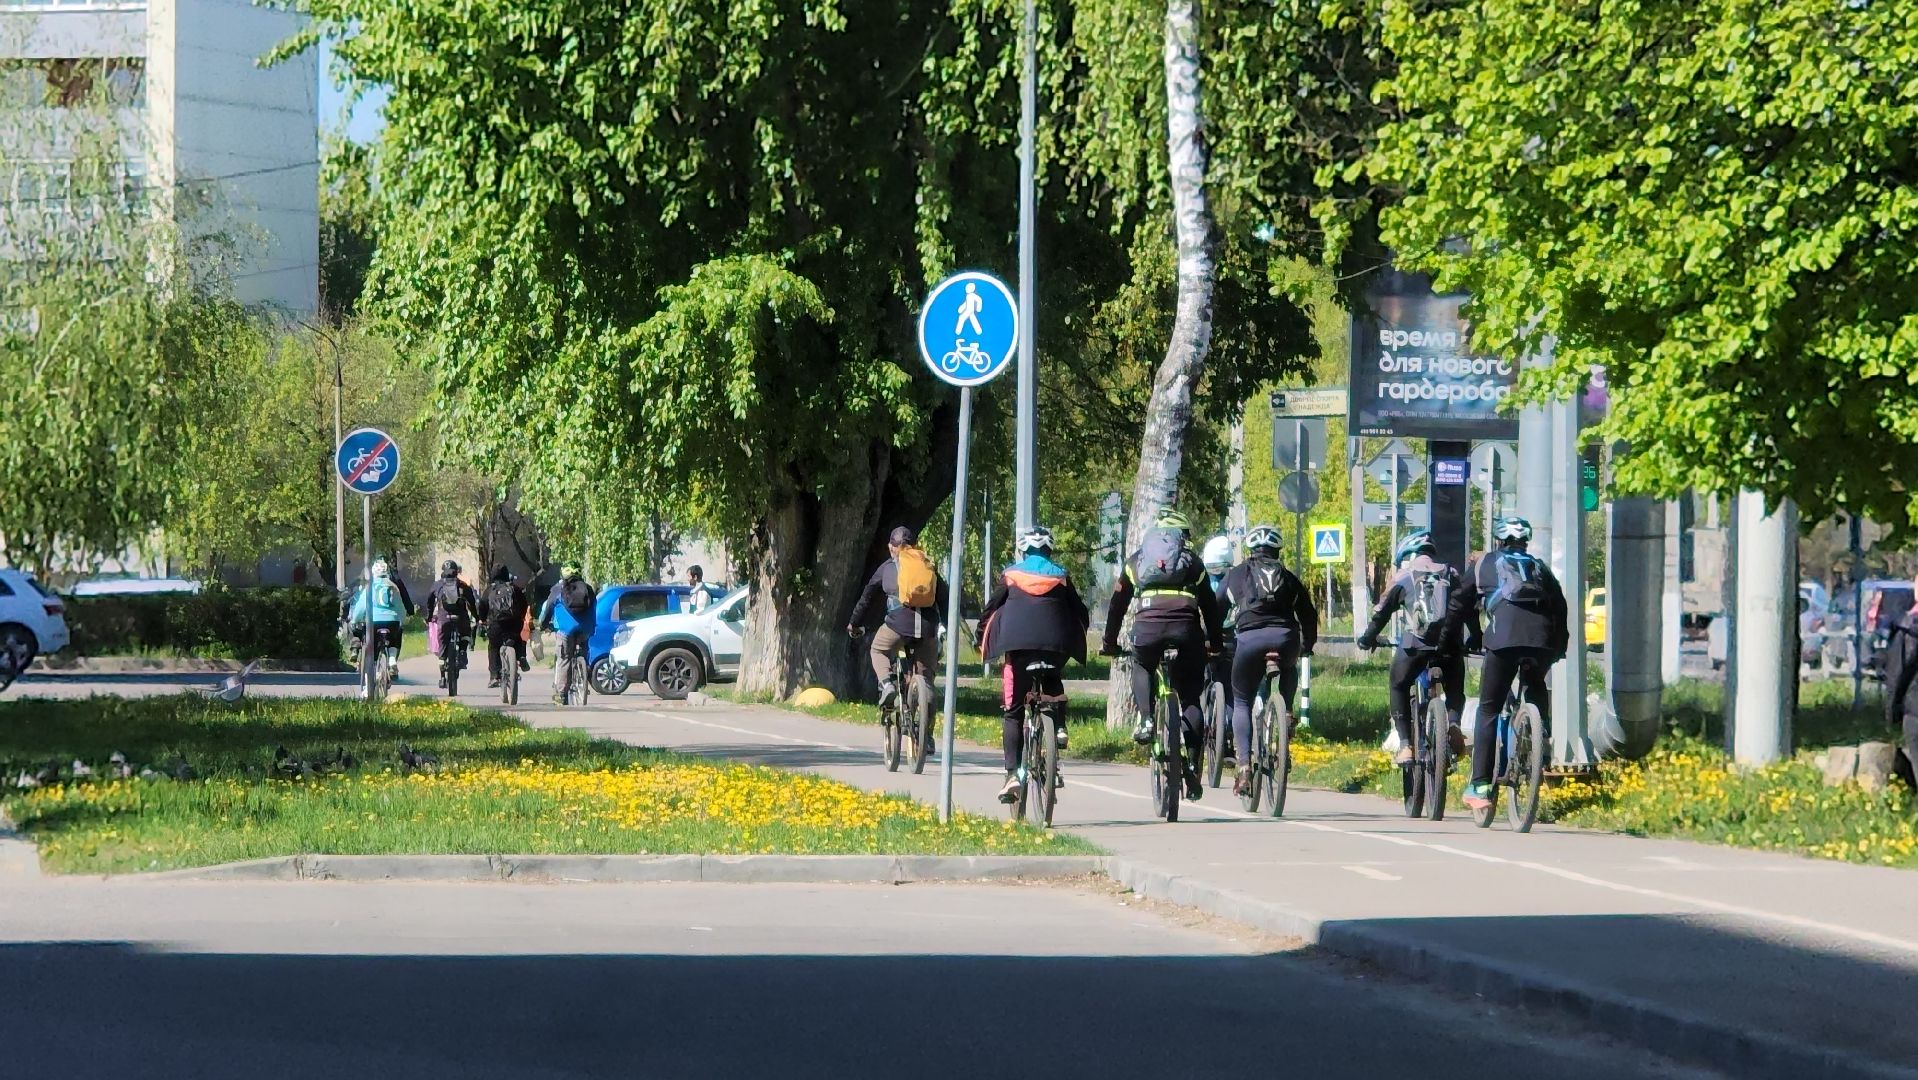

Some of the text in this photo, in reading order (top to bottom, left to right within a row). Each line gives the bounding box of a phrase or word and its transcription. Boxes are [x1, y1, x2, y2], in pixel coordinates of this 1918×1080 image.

[1379, 329, 1456, 351] время
[1379, 350, 1512, 376] для нового
[1378, 378, 1511, 404] гардероба
